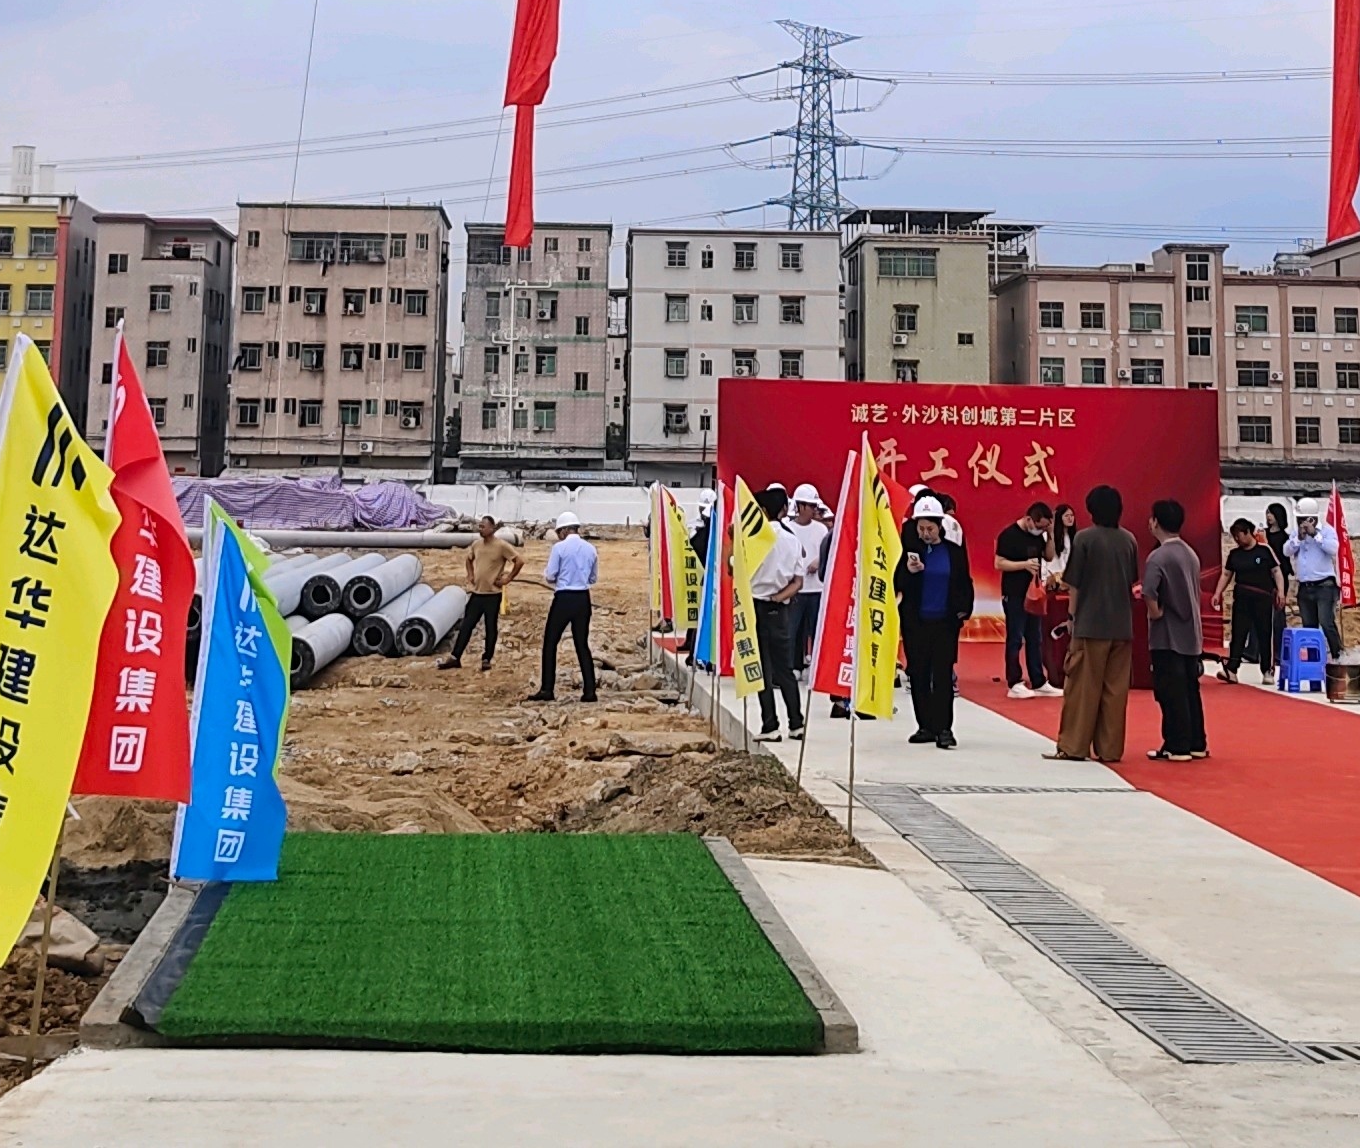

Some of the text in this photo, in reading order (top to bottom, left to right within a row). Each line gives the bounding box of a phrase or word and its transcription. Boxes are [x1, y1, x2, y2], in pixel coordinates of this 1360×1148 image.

[851, 403, 1076, 428] 诚艺·外沙科创城第二片区
[876, 437, 1058, 494] 开工仪式
